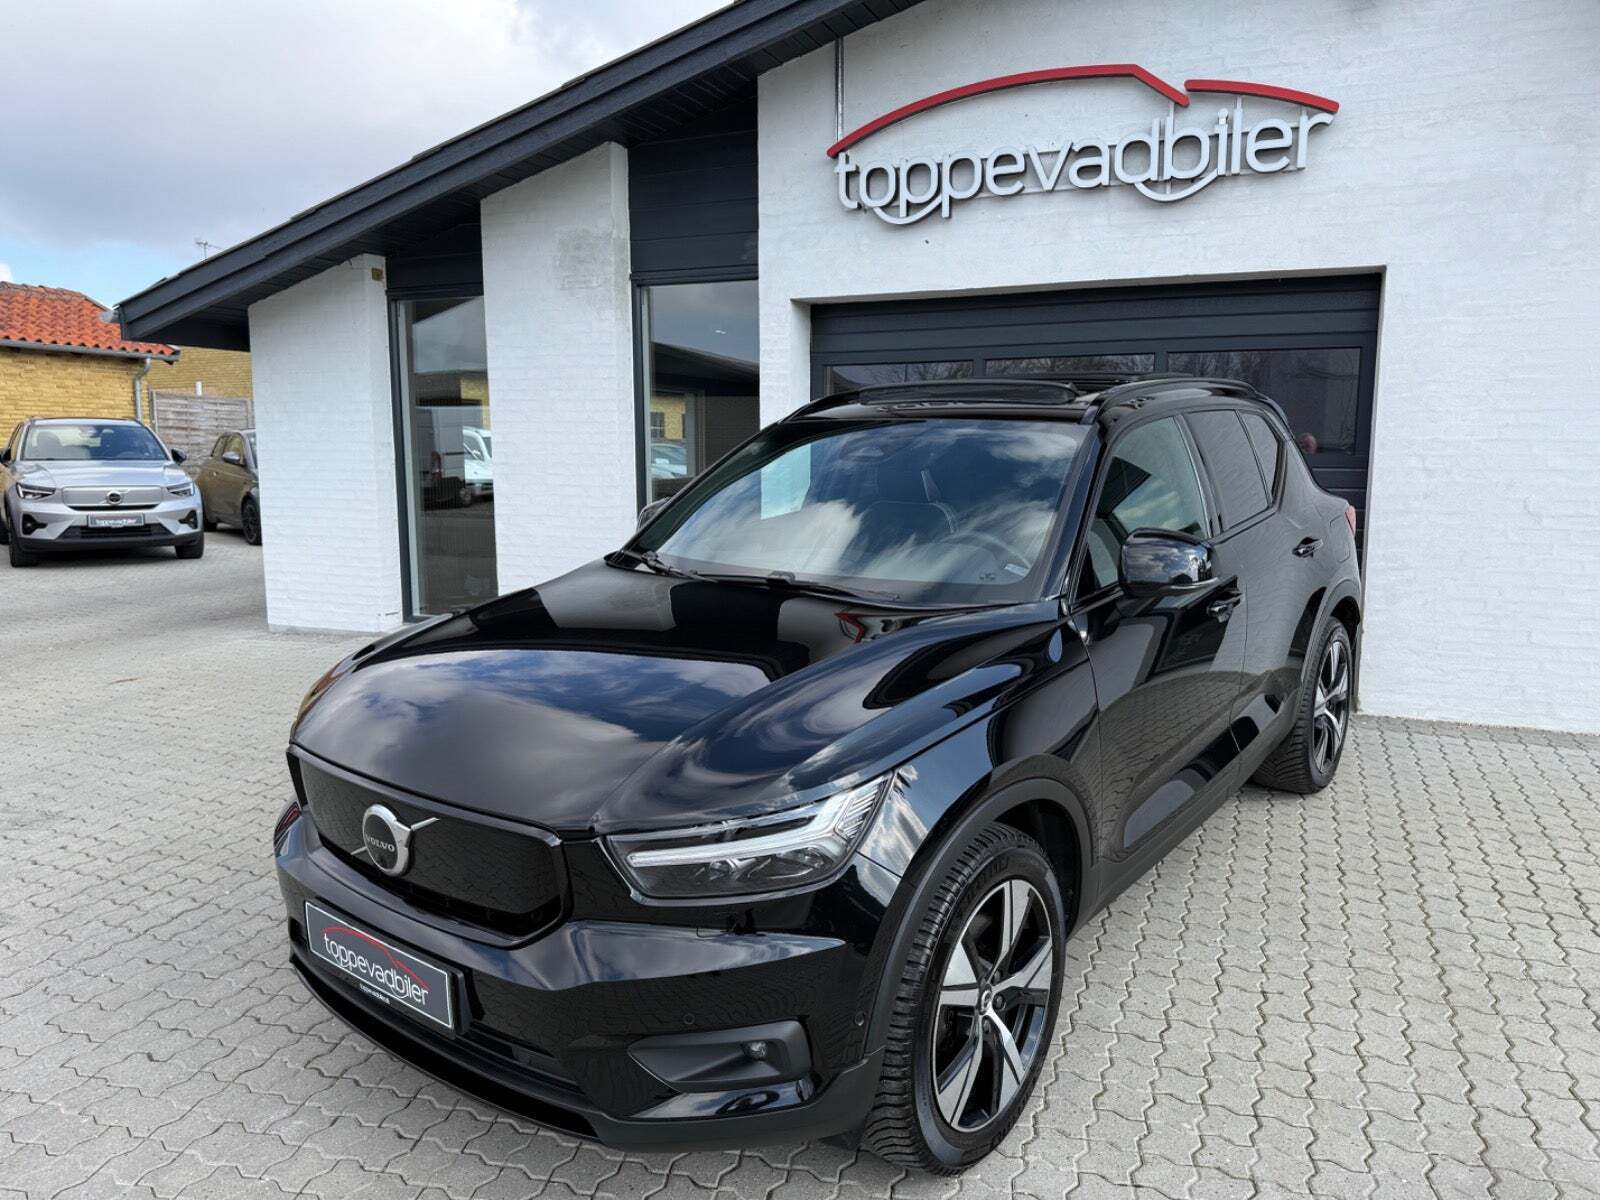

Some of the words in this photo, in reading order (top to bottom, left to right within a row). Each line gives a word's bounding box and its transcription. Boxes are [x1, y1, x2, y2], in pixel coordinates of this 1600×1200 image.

[834, 105, 1334, 223] toppevadbiler
[365, 833, 395, 852] VOLVO
[324, 933, 428, 1005] toppevadbiler
